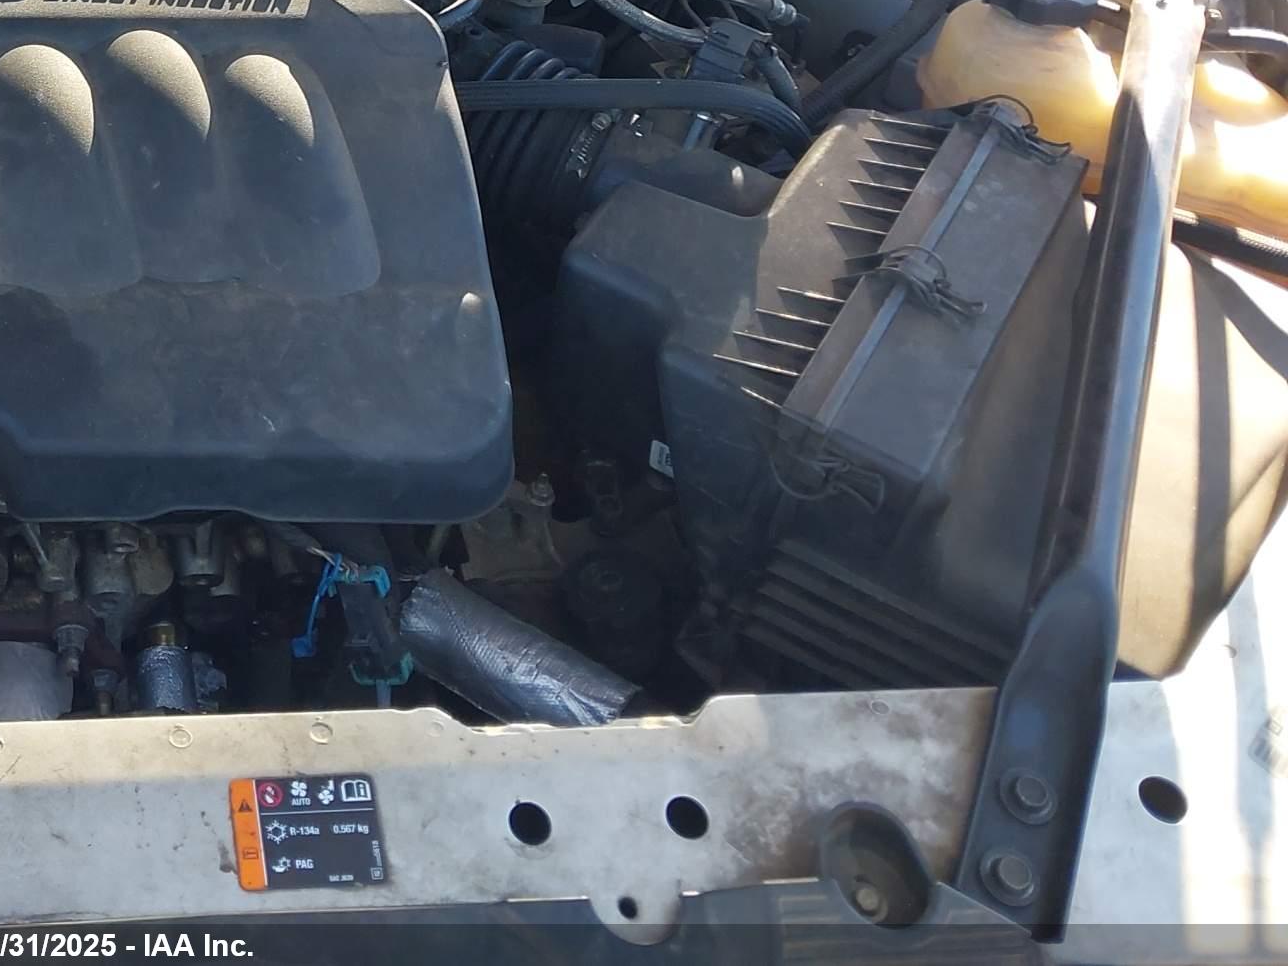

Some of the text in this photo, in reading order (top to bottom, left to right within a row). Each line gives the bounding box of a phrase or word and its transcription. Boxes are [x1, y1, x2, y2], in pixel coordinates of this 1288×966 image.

[291, 797, 312, 806] AUTO
[289, 823, 369, 836] R-134a 0.567 kg
[295, 859, 314, 870] PAG
